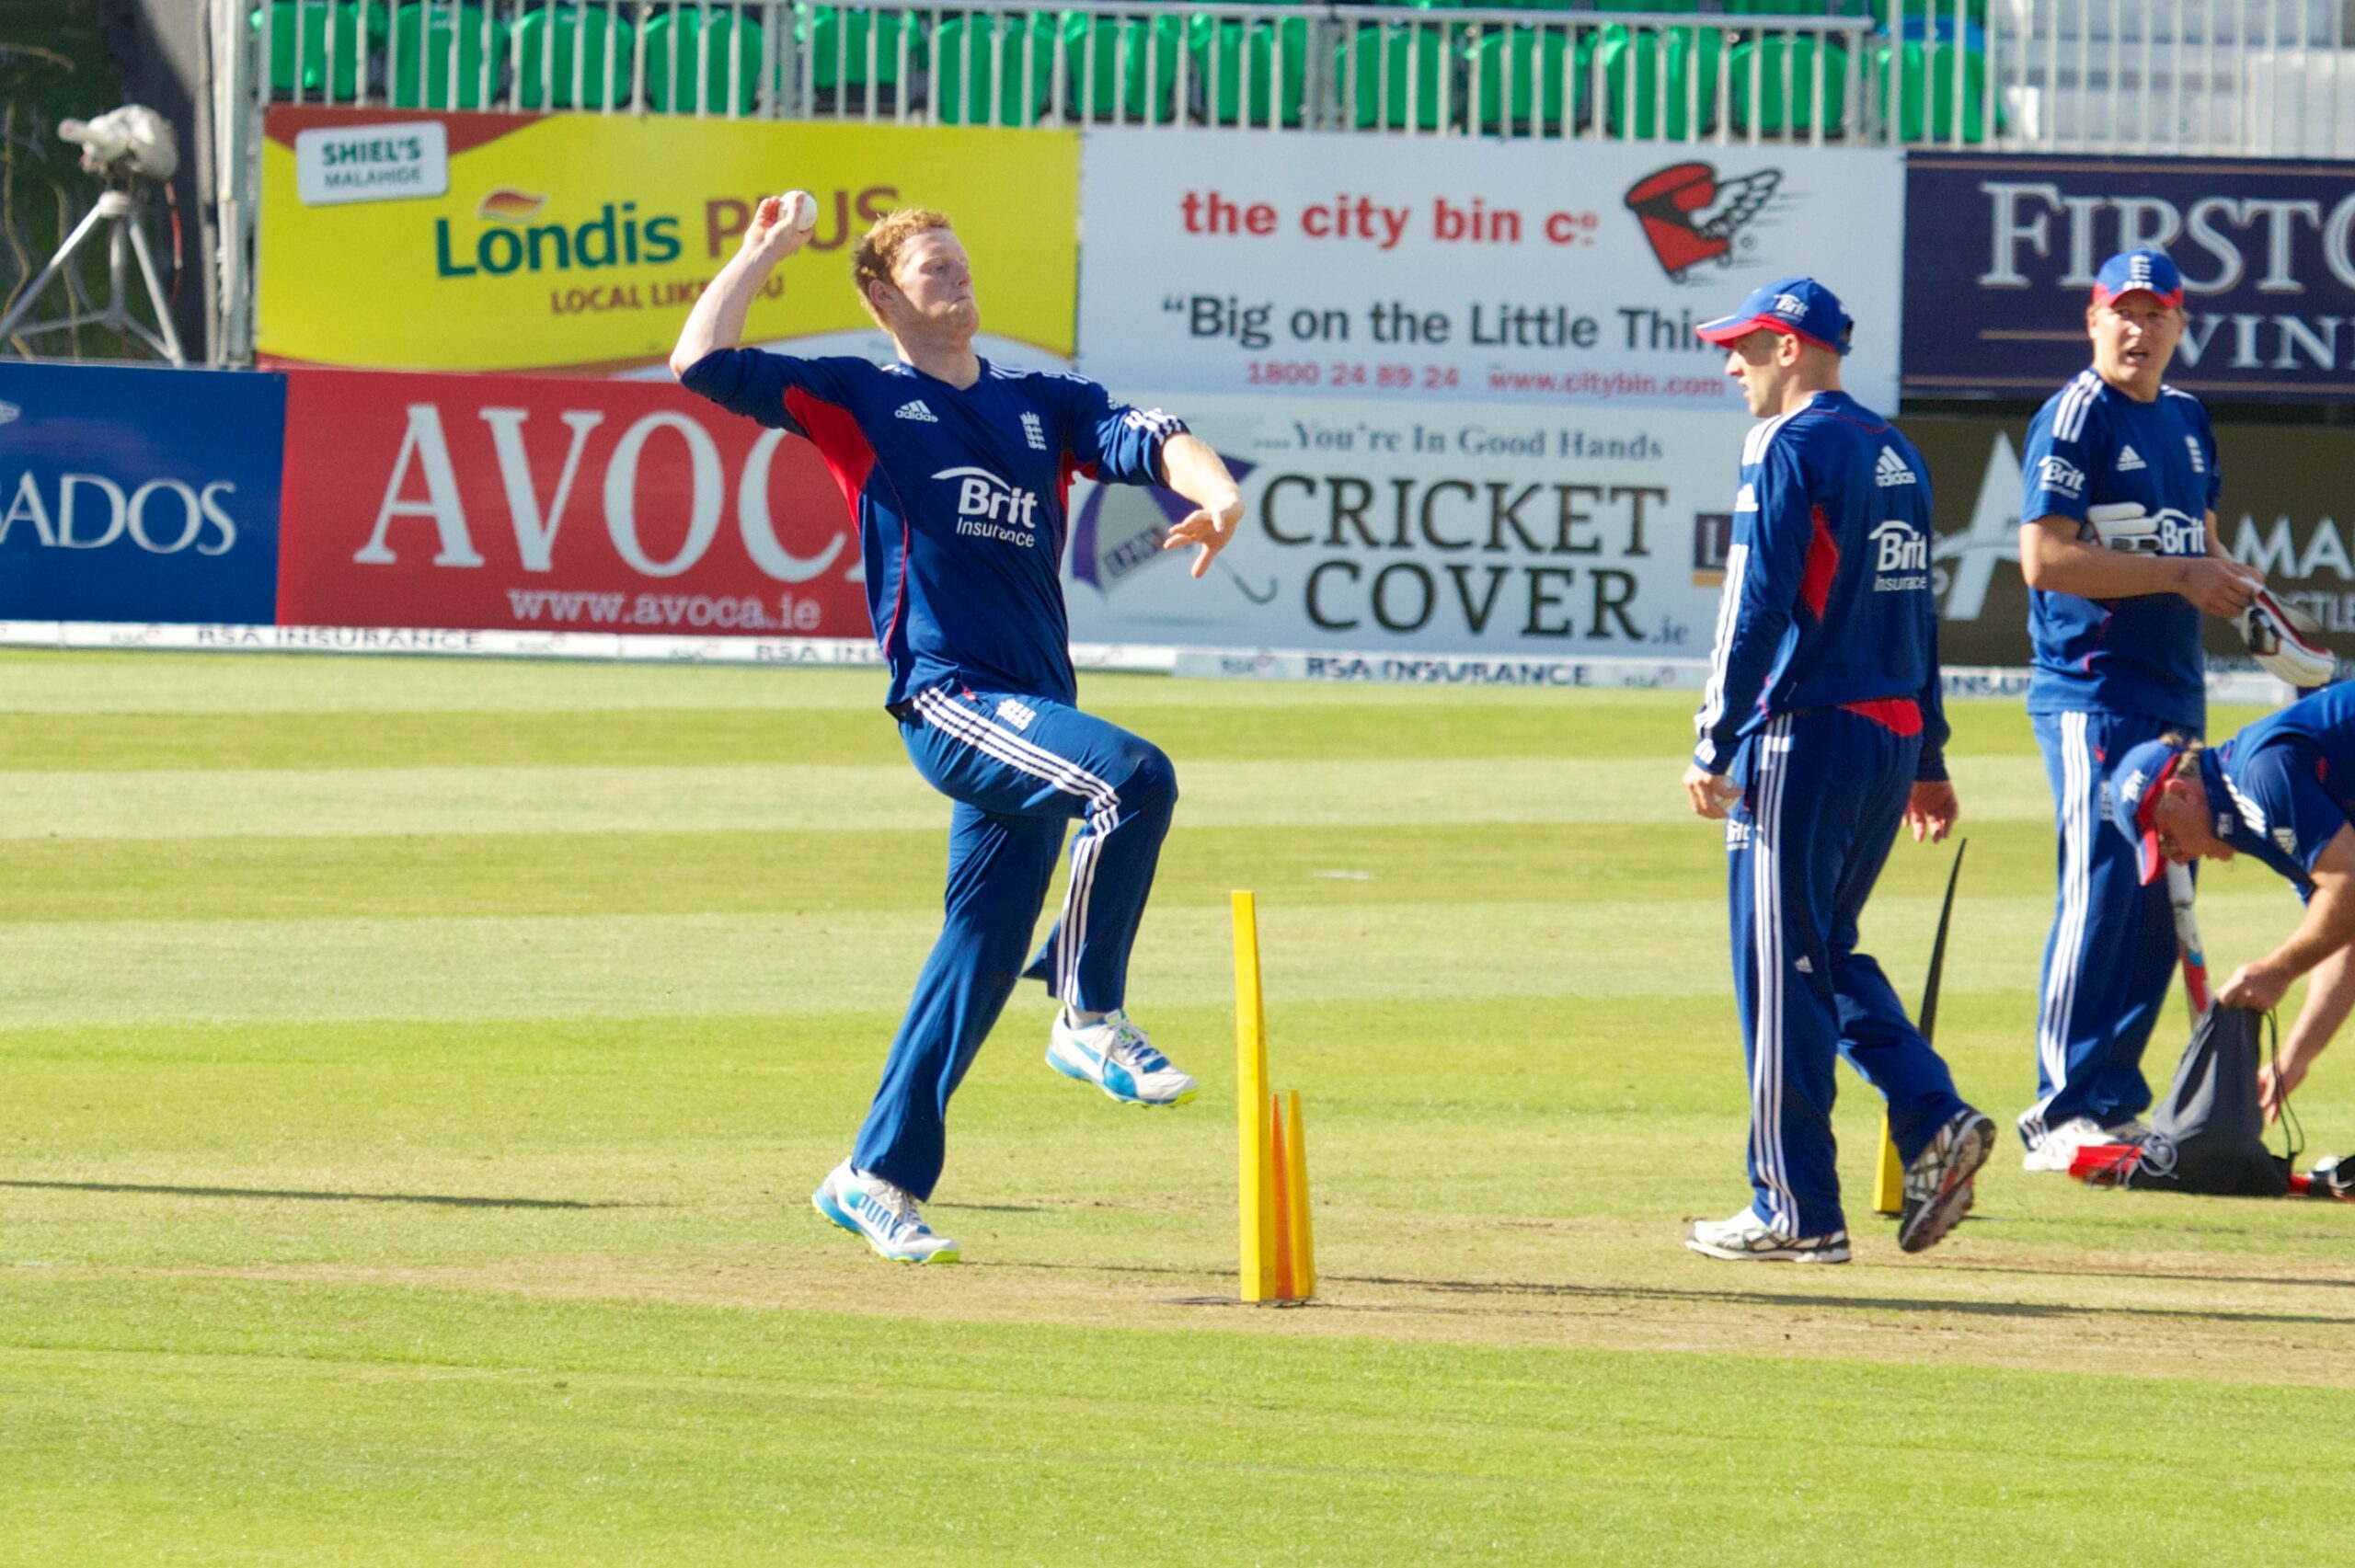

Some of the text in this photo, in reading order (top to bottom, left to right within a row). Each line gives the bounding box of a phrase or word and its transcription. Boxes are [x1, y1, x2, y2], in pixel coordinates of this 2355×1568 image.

[322, 136, 421, 166] SHIEL'S
[435, 186, 899, 278] Londis PUS
[1181, 191, 1278, 235] the
[1301, 194, 1411, 250] city
[1433, 197, 1521, 243] bin
[551, 281, 641, 314] LOCAL
[1290, 308, 1349, 341] on
[1369, 303, 1451, 343] the
[1472, 303, 1600, 348] Little
[2178, 313, 2355, 370] VIN
[895, 409, 938, 423] adidas
[1413, 424, 1445, 452] In
[1459, 426, 1546, 457] Good
[1561, 430, 1662, 460] Hands
[353, 403, 866, 582] AVOC
[2041, 462, 2085, 491] Brit
[0, 471, 237, 555] ADOS
[958, 477, 1038, 529] Brit
[1260, 475, 1669, 555] CRICKET
[956, 517, 1036, 548] Insurance
[1877, 531, 1927, 571] Brit
[2162, 517, 2206, 554] Brit
[2233, 514, 2355, 581] MA
[508, 589, 821, 630] www.avoca.ie
[197, 629, 482, 649] RSA INSURANCE
[756, 645, 821, 662] RSA
[1306, 657, 1592, 687] RSA INSURANCE
